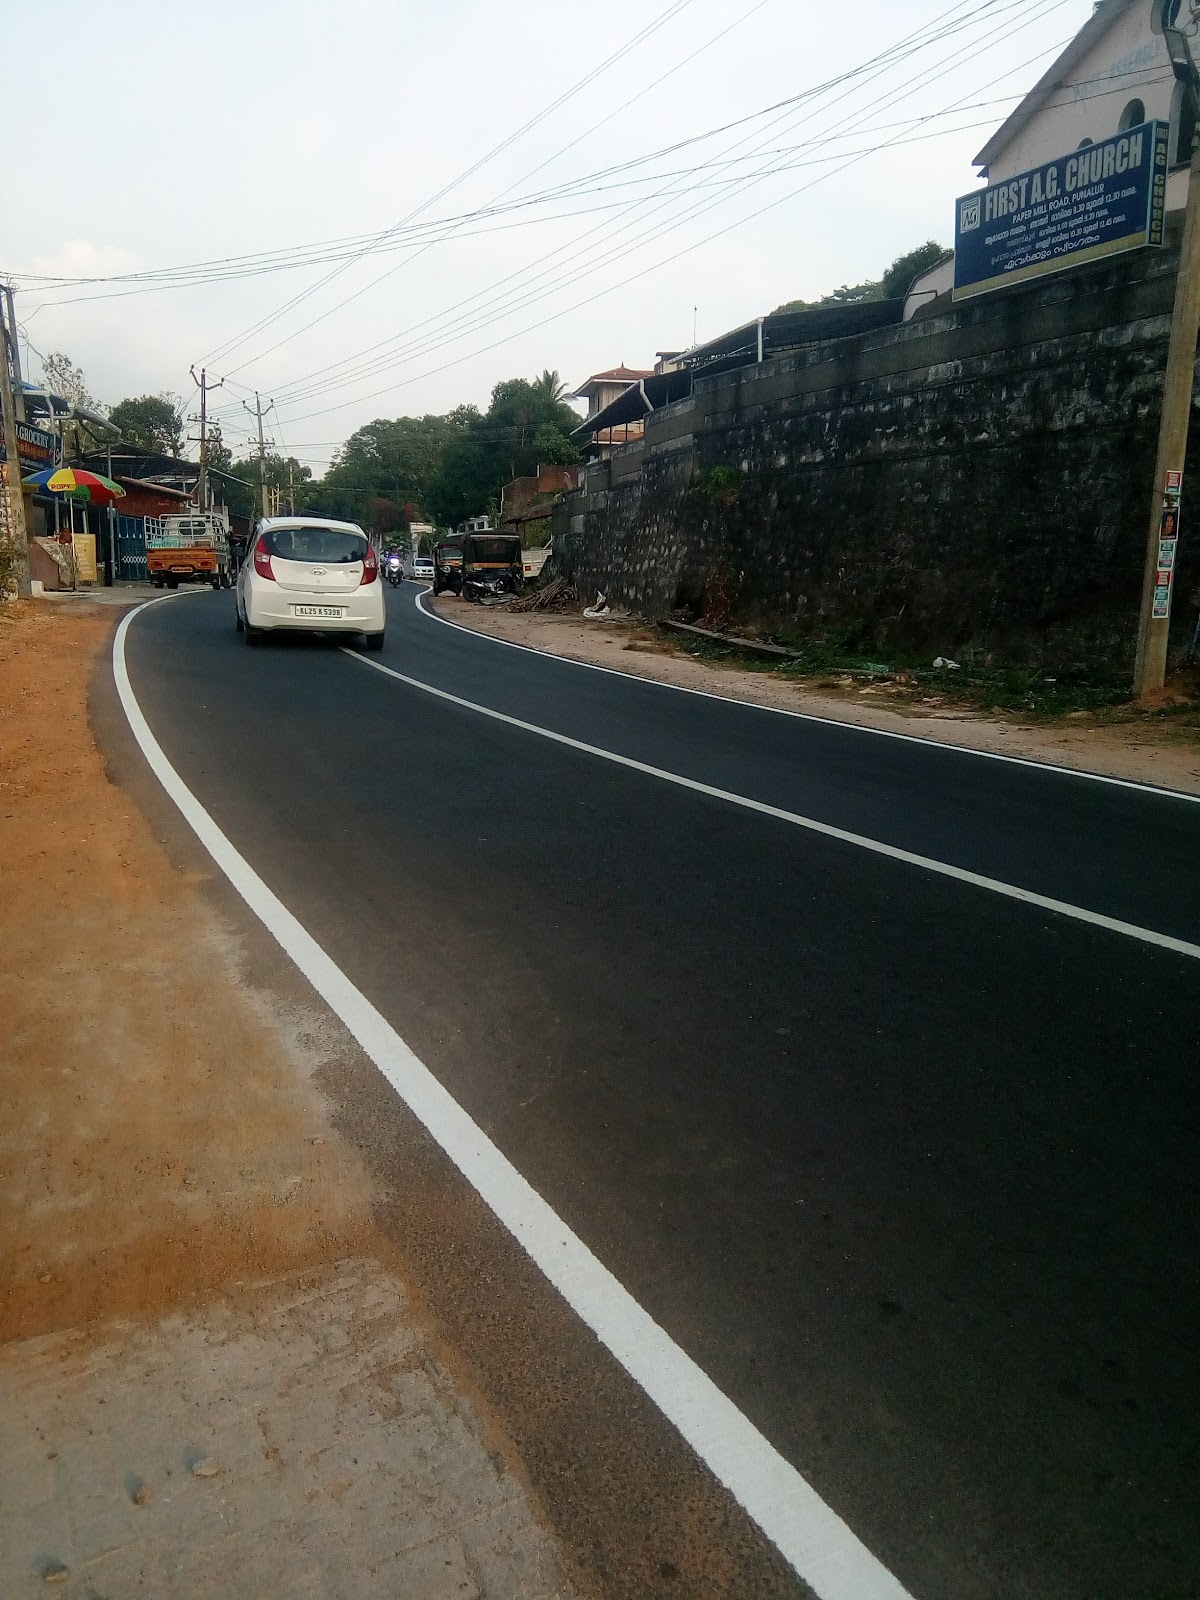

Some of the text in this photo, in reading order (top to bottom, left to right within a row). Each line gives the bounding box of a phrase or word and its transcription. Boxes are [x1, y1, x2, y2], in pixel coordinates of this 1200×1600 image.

[984, 132, 1142, 221] FIRST A.G. CHURCH
[1012, 183, 1104, 222] PAPER MILL ROAD, PUNALUR
[1072, 203, 1084, 214] 9.30
[1105, 191, 1119, 201] 12.30
